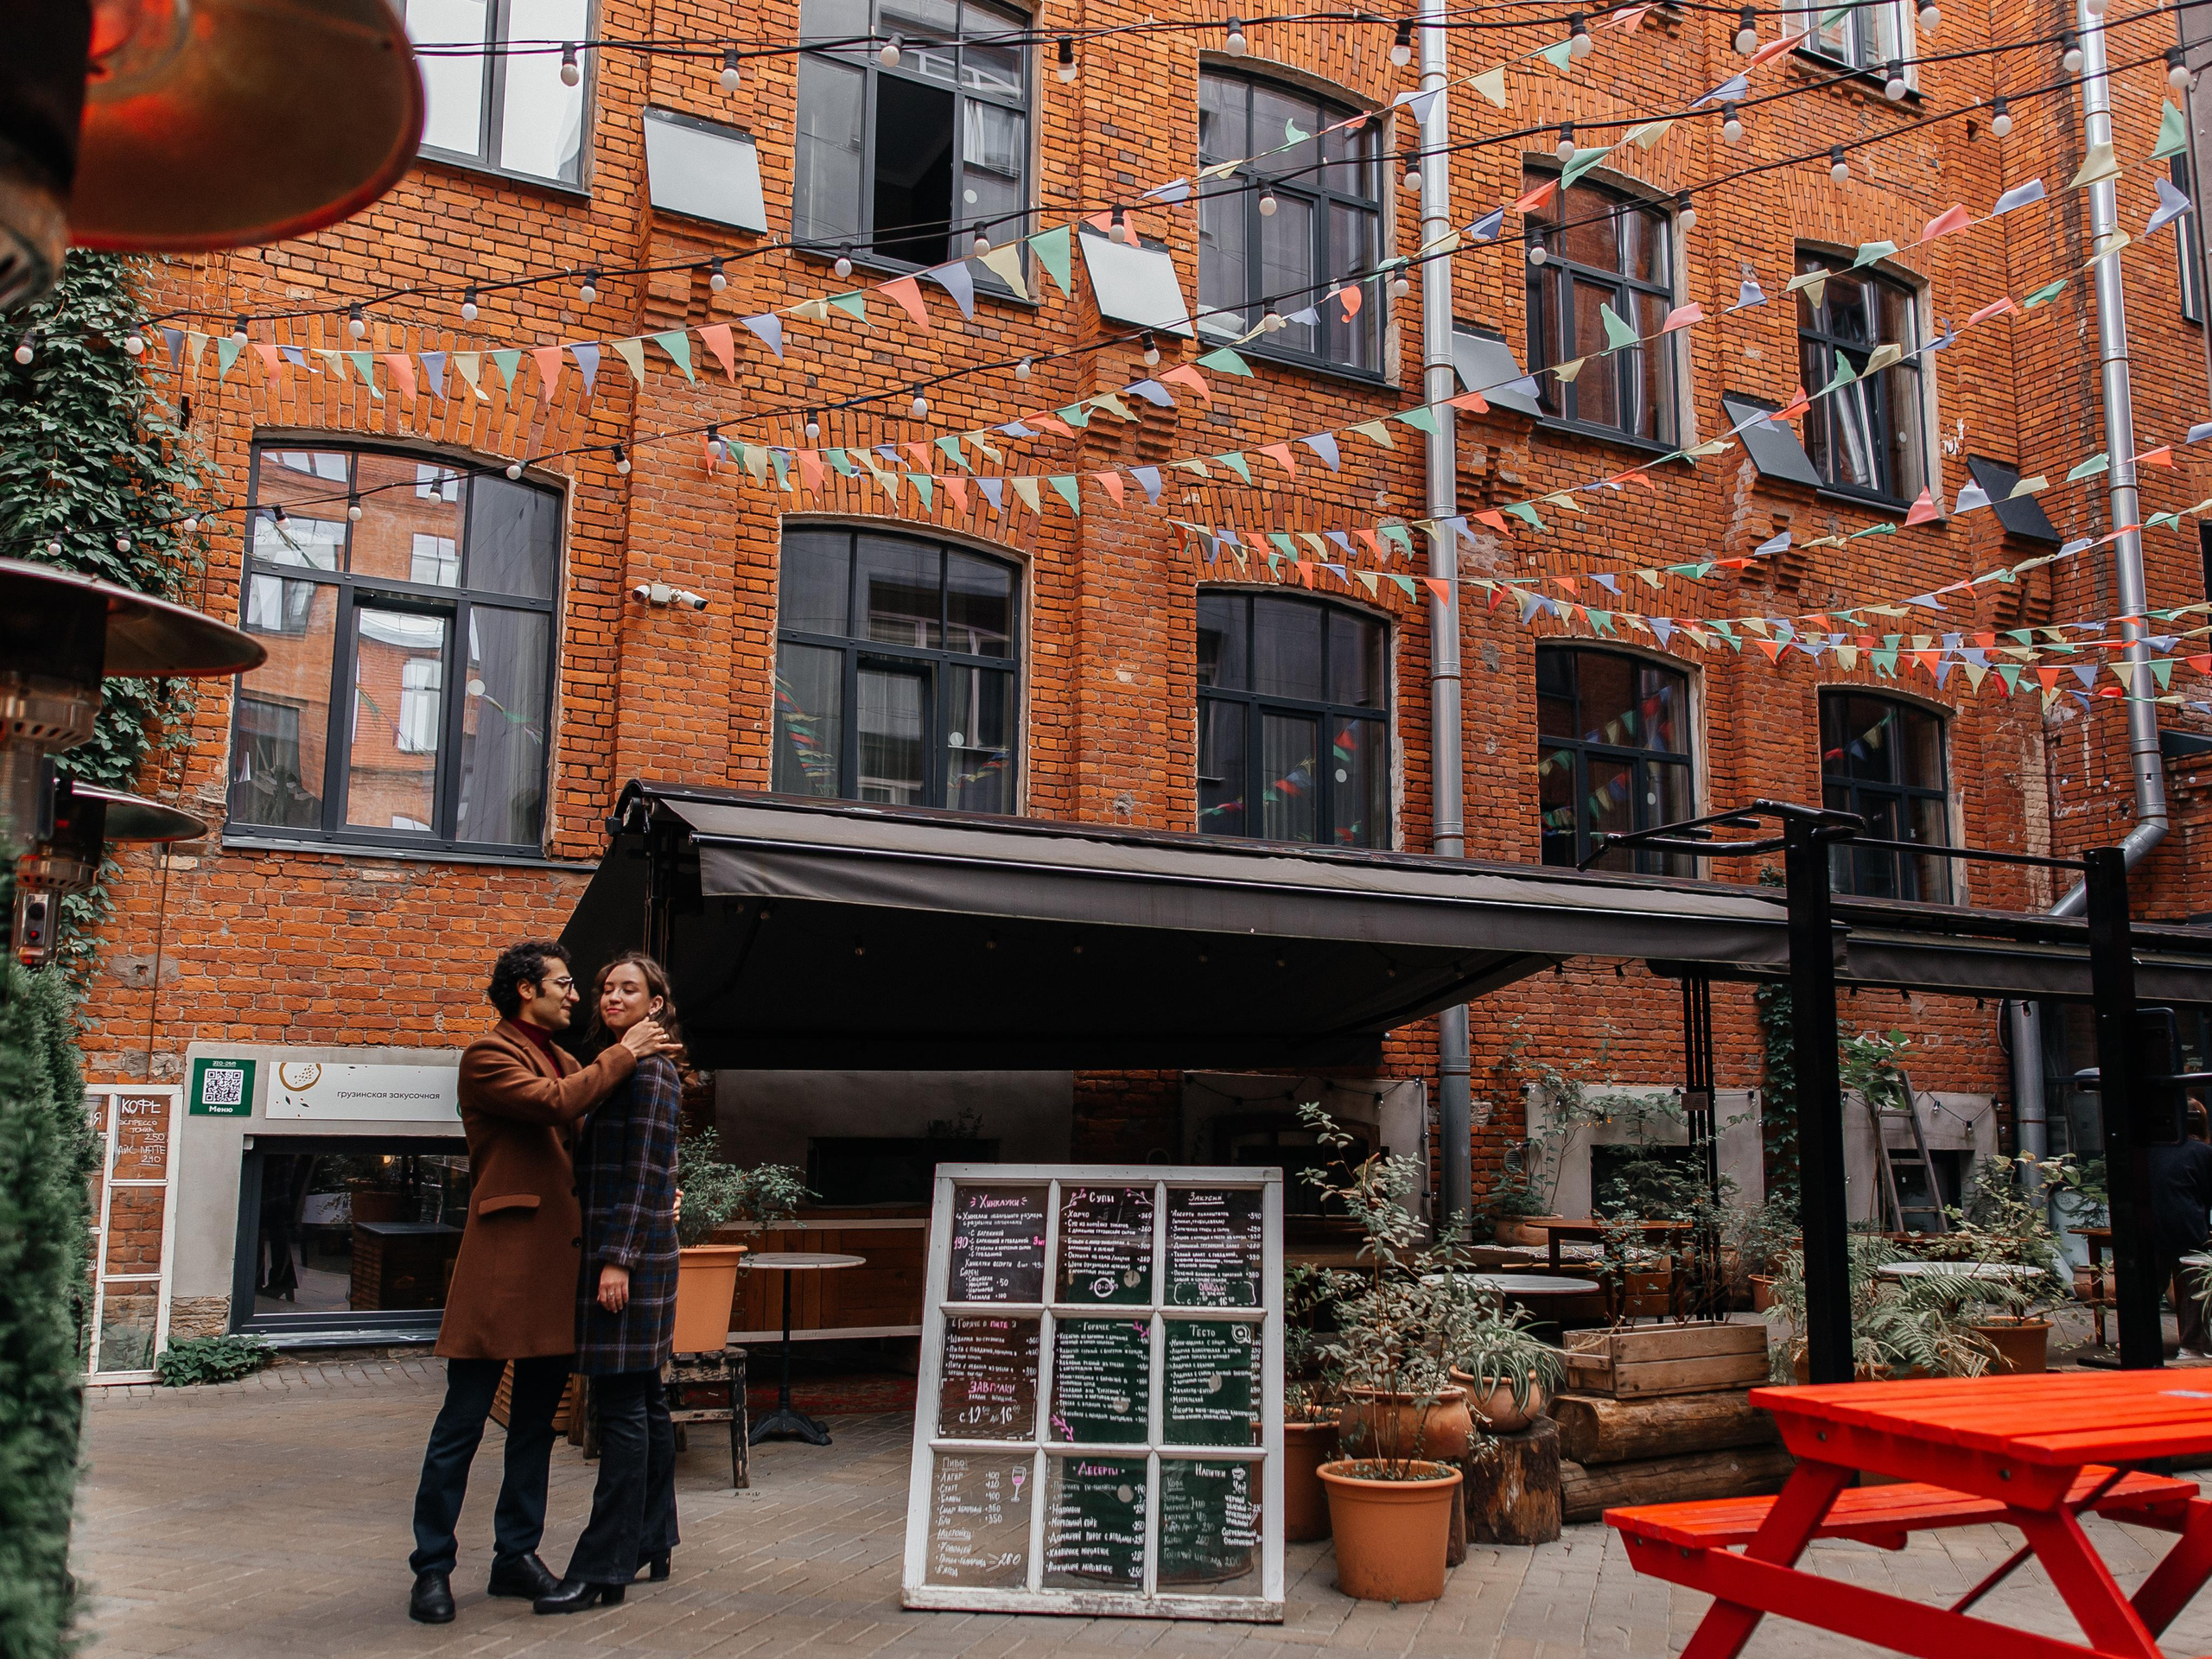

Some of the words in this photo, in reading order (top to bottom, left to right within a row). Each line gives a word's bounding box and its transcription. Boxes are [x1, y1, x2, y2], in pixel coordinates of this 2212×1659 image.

[122, 1098, 161, 1114] КОФЕ
[1090, 1192, 1115, 1203] Супы
[1067, 1210, 1090, 1218] Харчо
[954, 1236, 968, 1249] 190
[1000, 1278, 1008, 1287] 50
[1189, 1324, 1216, 1337] Тесто
